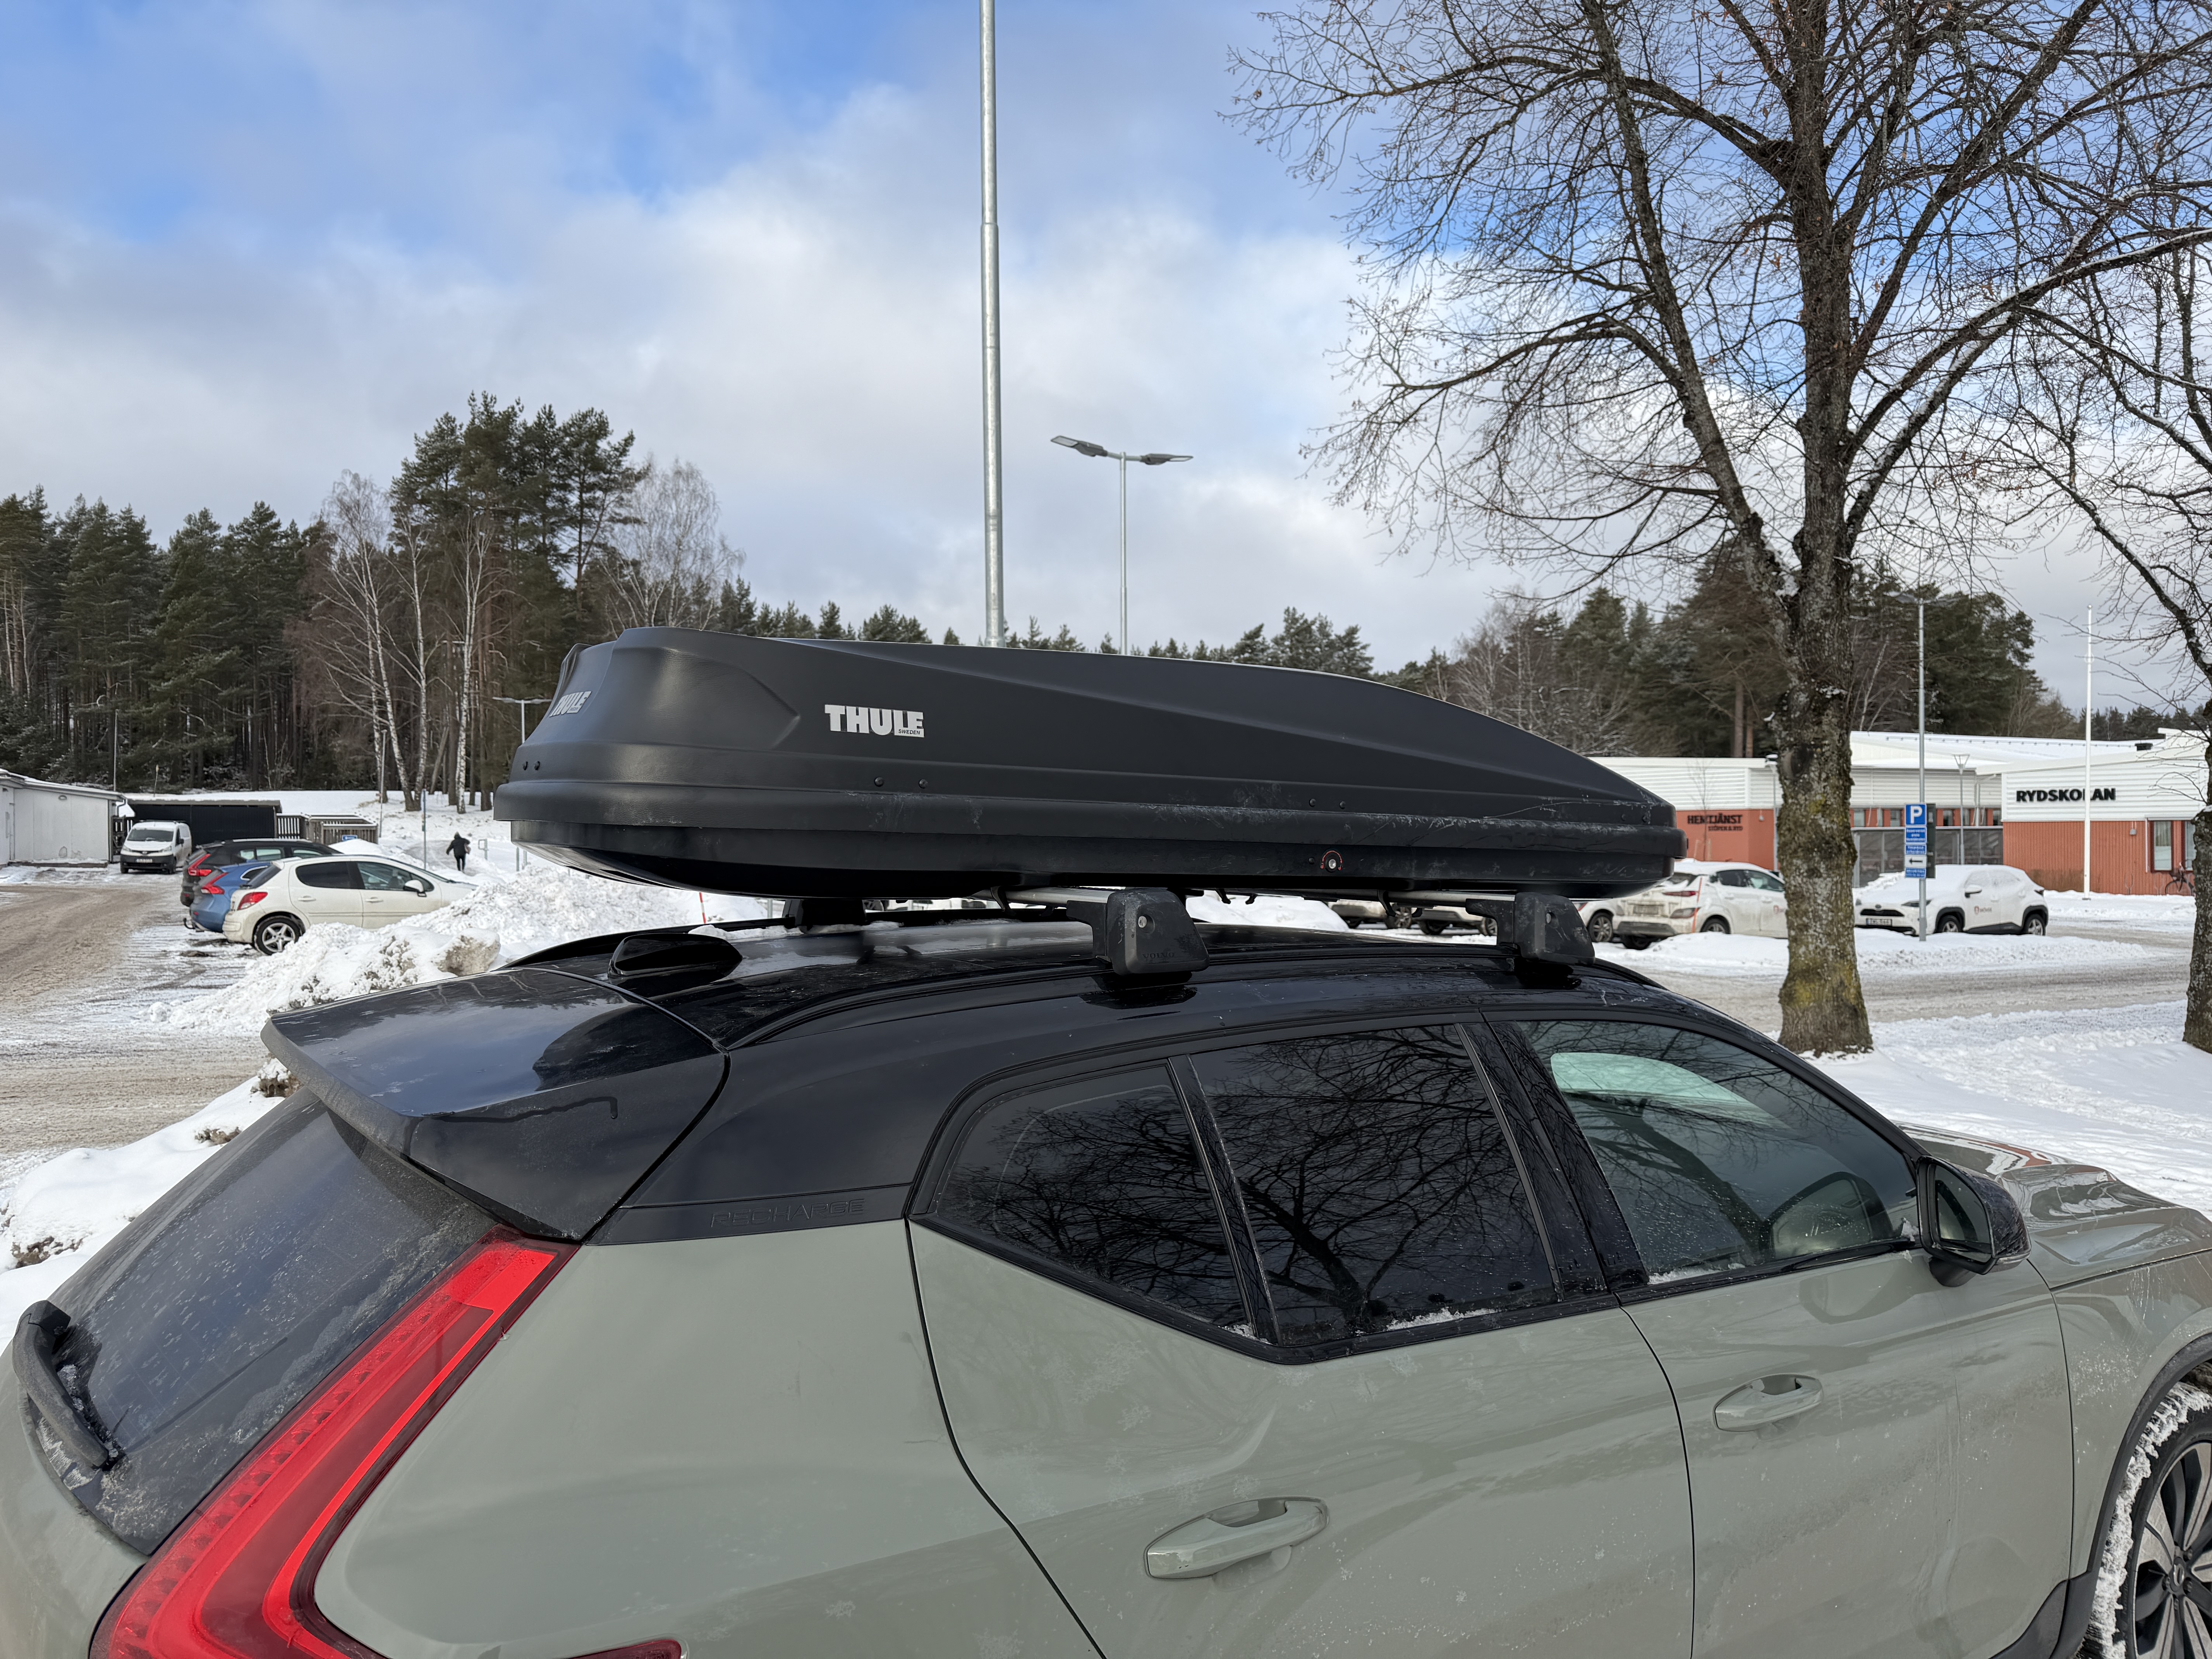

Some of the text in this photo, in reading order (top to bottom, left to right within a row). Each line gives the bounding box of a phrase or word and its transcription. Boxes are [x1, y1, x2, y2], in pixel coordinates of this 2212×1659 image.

[550, 691, 592, 717] THULE
[824, 704, 924, 737] THULE
[1910, 805, 1923, 824] P
[711, 1199, 865, 1228] RECHARGE
